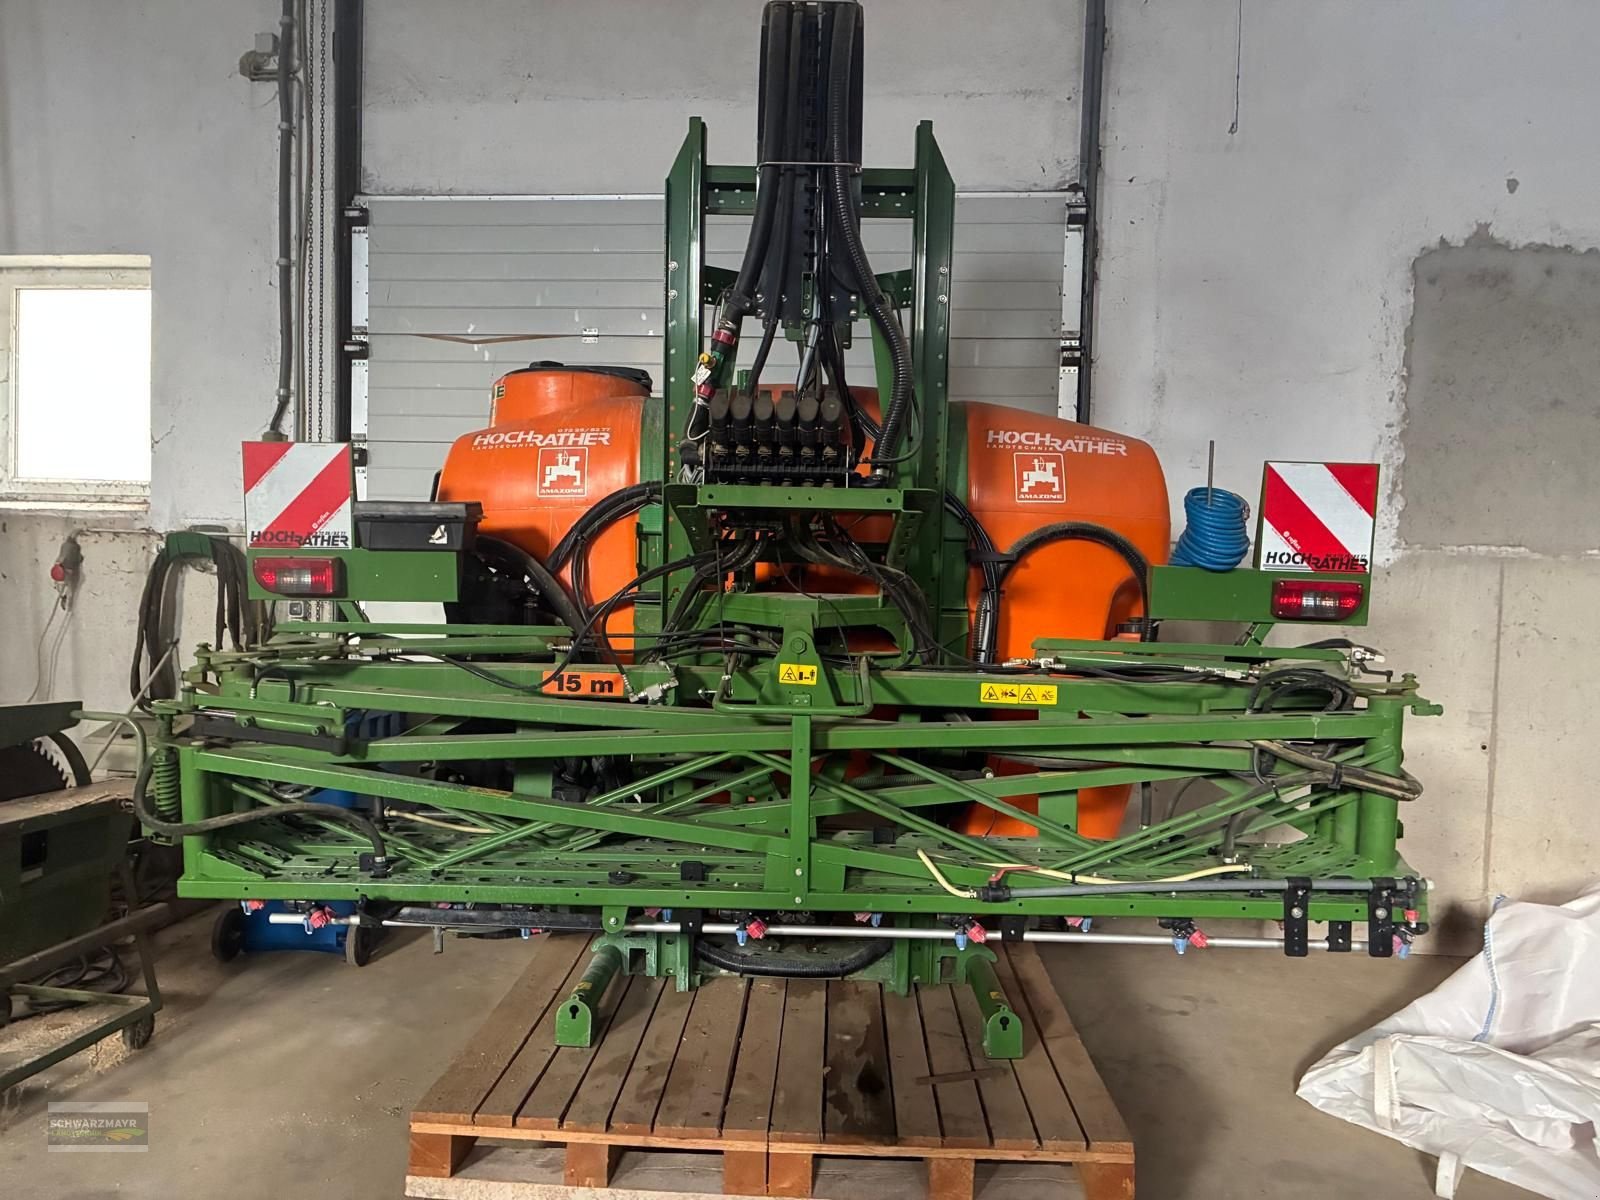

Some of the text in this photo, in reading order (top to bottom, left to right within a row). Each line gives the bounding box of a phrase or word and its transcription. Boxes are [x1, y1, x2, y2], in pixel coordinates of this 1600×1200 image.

[473, 430, 611, 446] HOCHRATHER
[987, 430, 1128, 457] HOCHRATHER
[250, 530, 350, 547] HOCHRATHER
[1266, 551, 1369, 571] HOCHRATHER
[553, 673, 614, 693] 15 m
